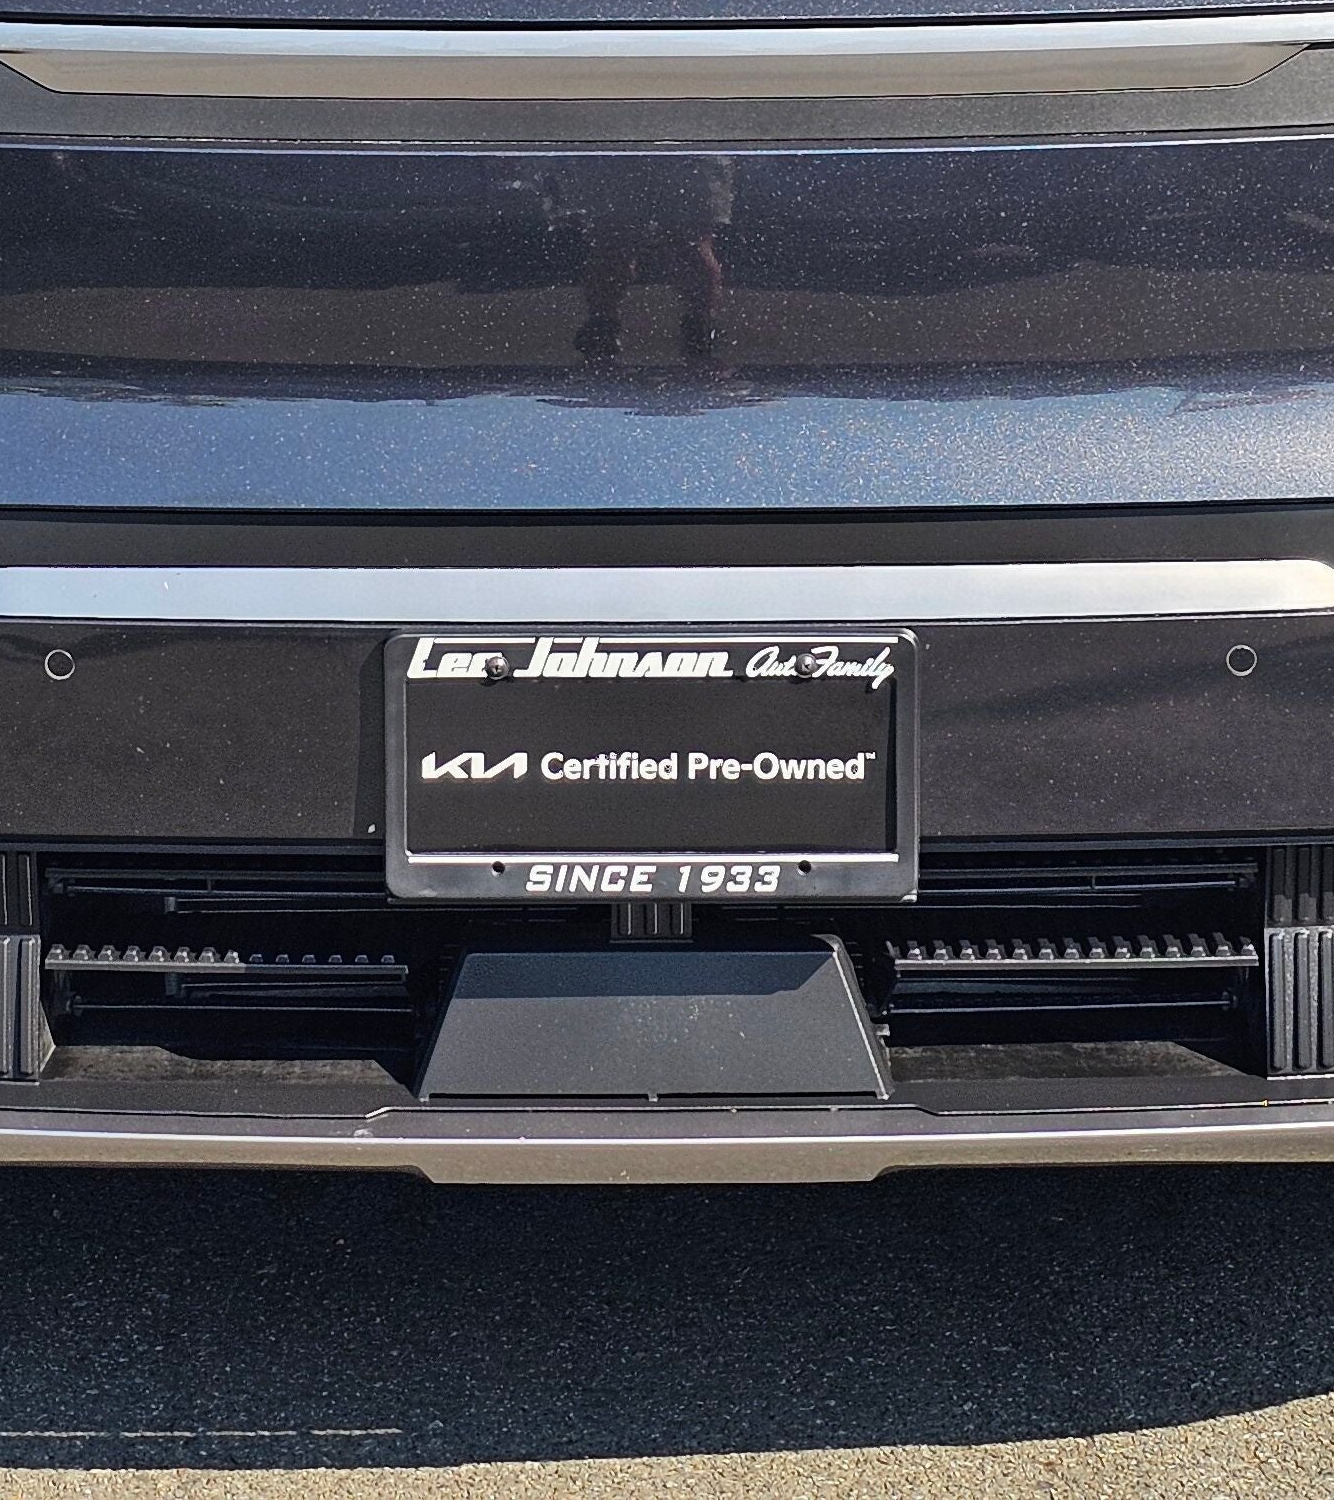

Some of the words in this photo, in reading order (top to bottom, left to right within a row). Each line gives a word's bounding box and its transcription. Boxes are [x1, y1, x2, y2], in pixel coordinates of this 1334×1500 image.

[513, 636, 734, 678] Johnson
[745, 645, 811, 678] Aut
[810, 645, 895, 690] Family
[421, 751, 529, 780] KIA
[540, 751, 679, 781] Certified
[525, 864, 658, 893] SINCE
[677, 864, 782, 893] 1933
